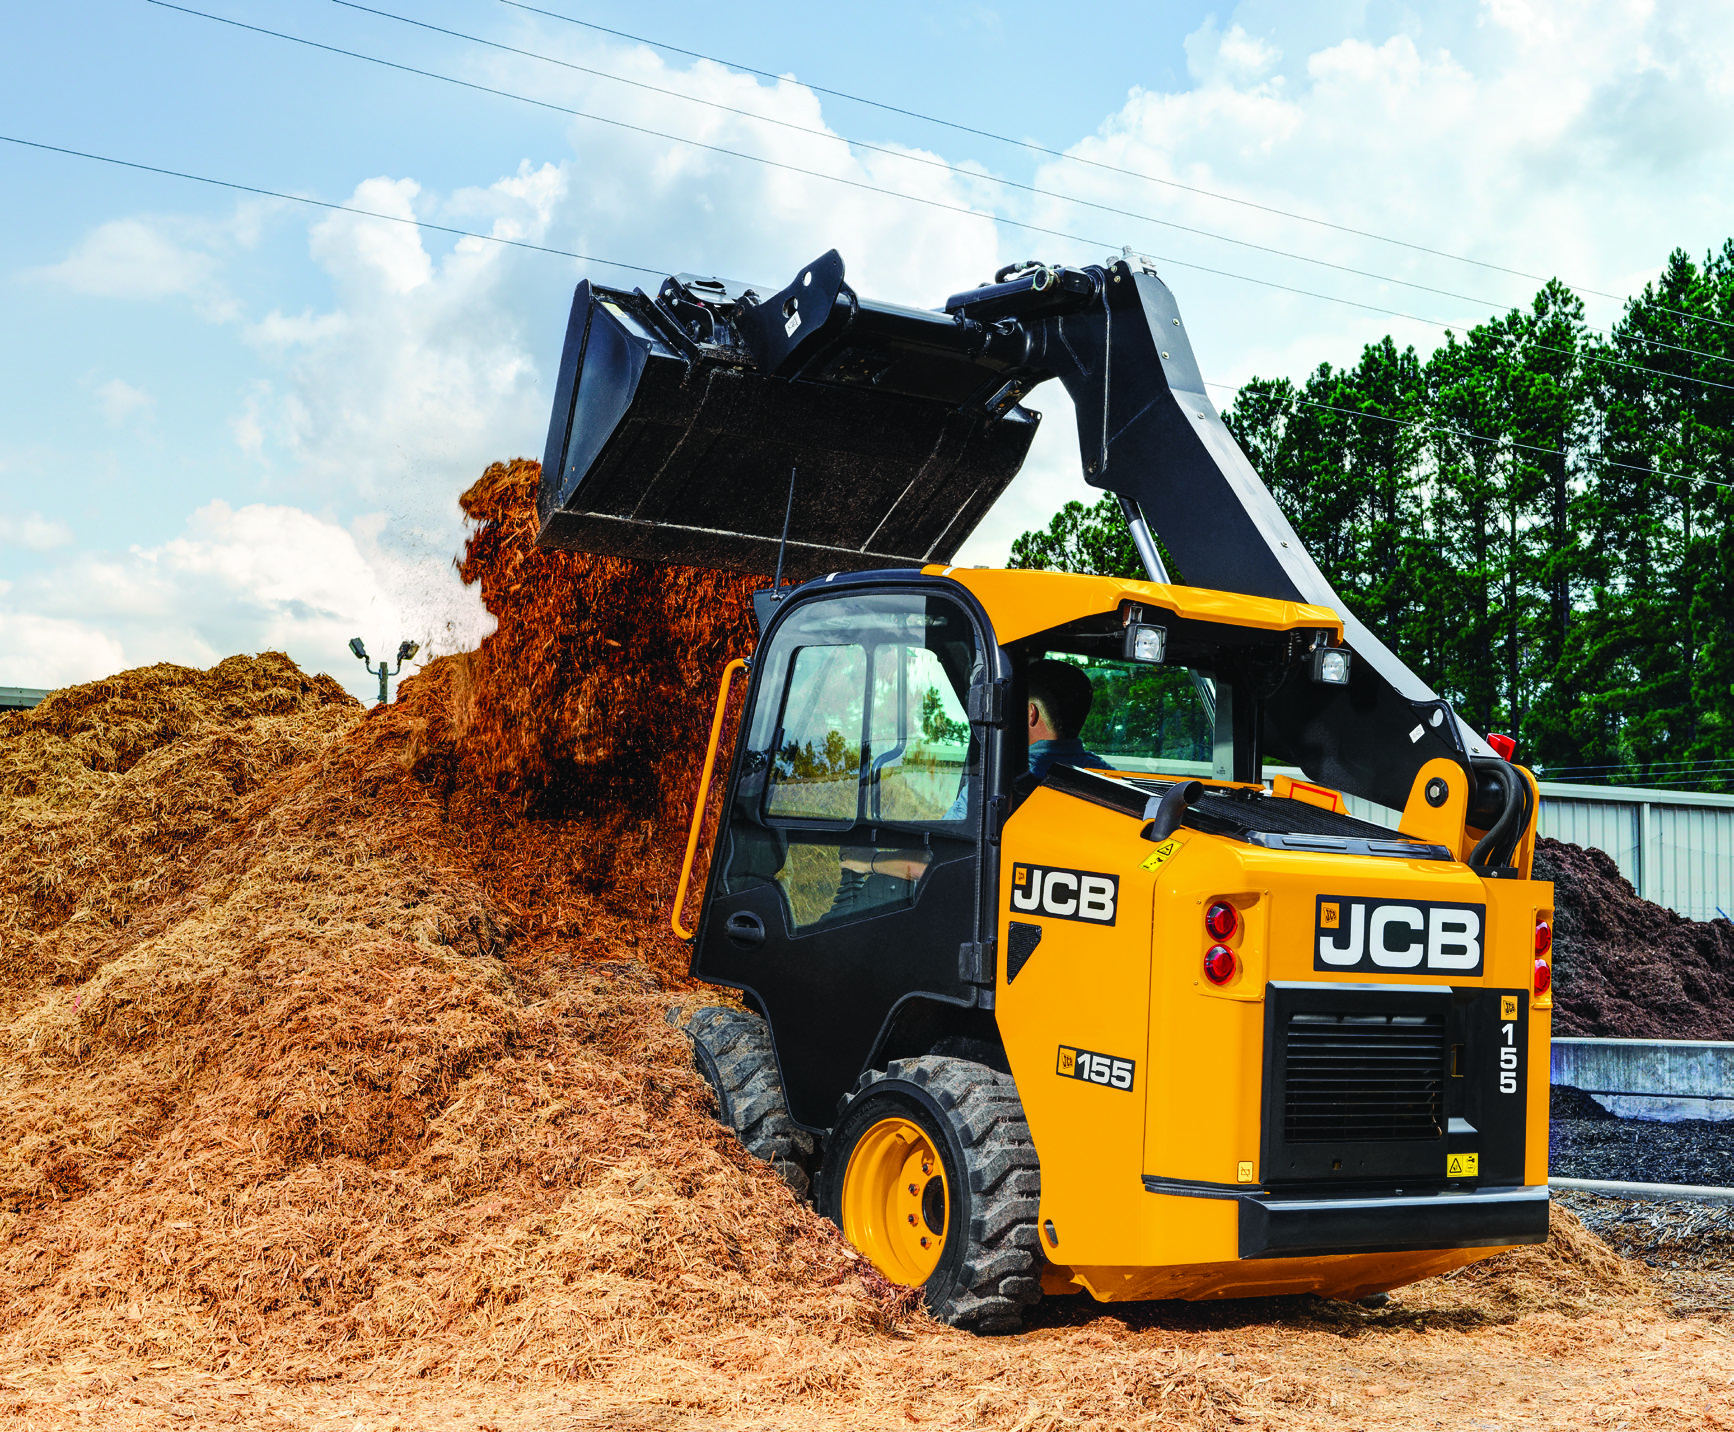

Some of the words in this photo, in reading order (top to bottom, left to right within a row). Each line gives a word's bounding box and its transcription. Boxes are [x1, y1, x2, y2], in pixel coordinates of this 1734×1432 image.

[1013, 869, 1115, 920] JCB
[1319, 903, 1481, 970] JCB
[1077, 1053, 1132, 1089] 155
[1499, 1023, 1518, 1094] 155
